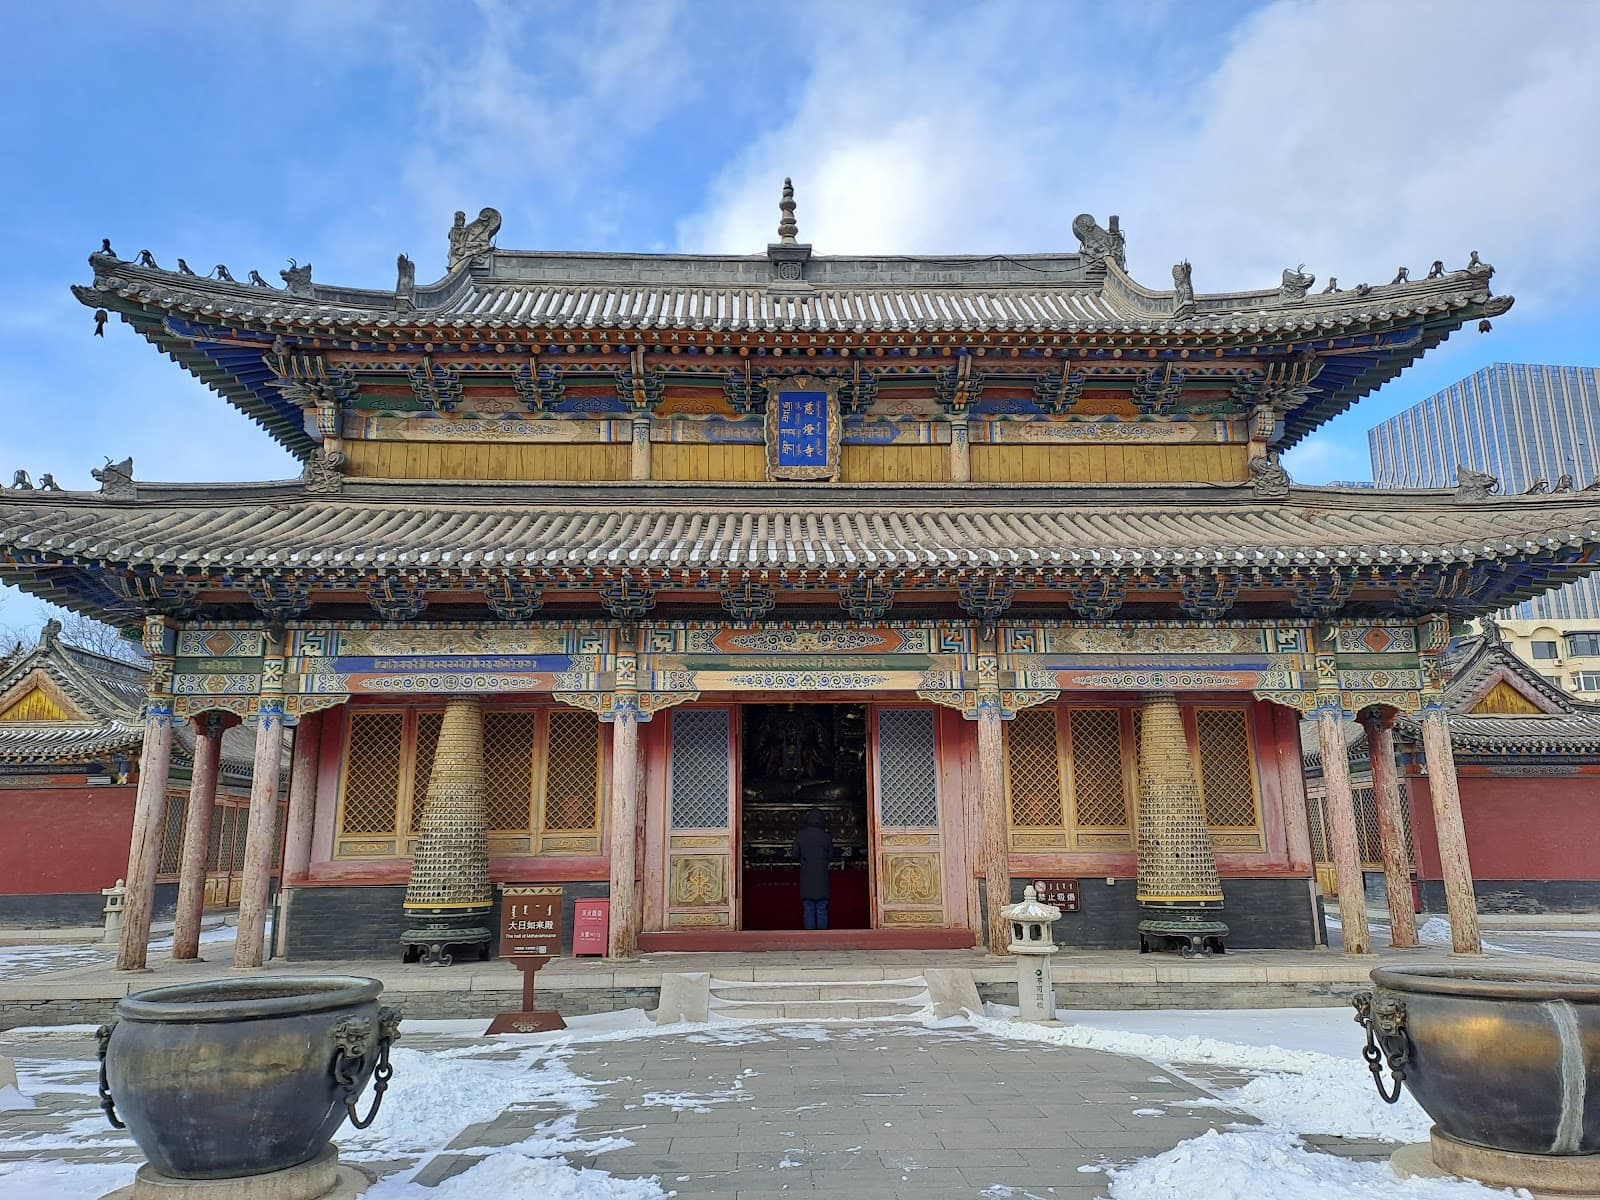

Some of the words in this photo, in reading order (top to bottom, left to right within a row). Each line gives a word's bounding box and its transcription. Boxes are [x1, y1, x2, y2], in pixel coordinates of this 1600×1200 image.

[508, 921, 554, 930] 大日如来殿
